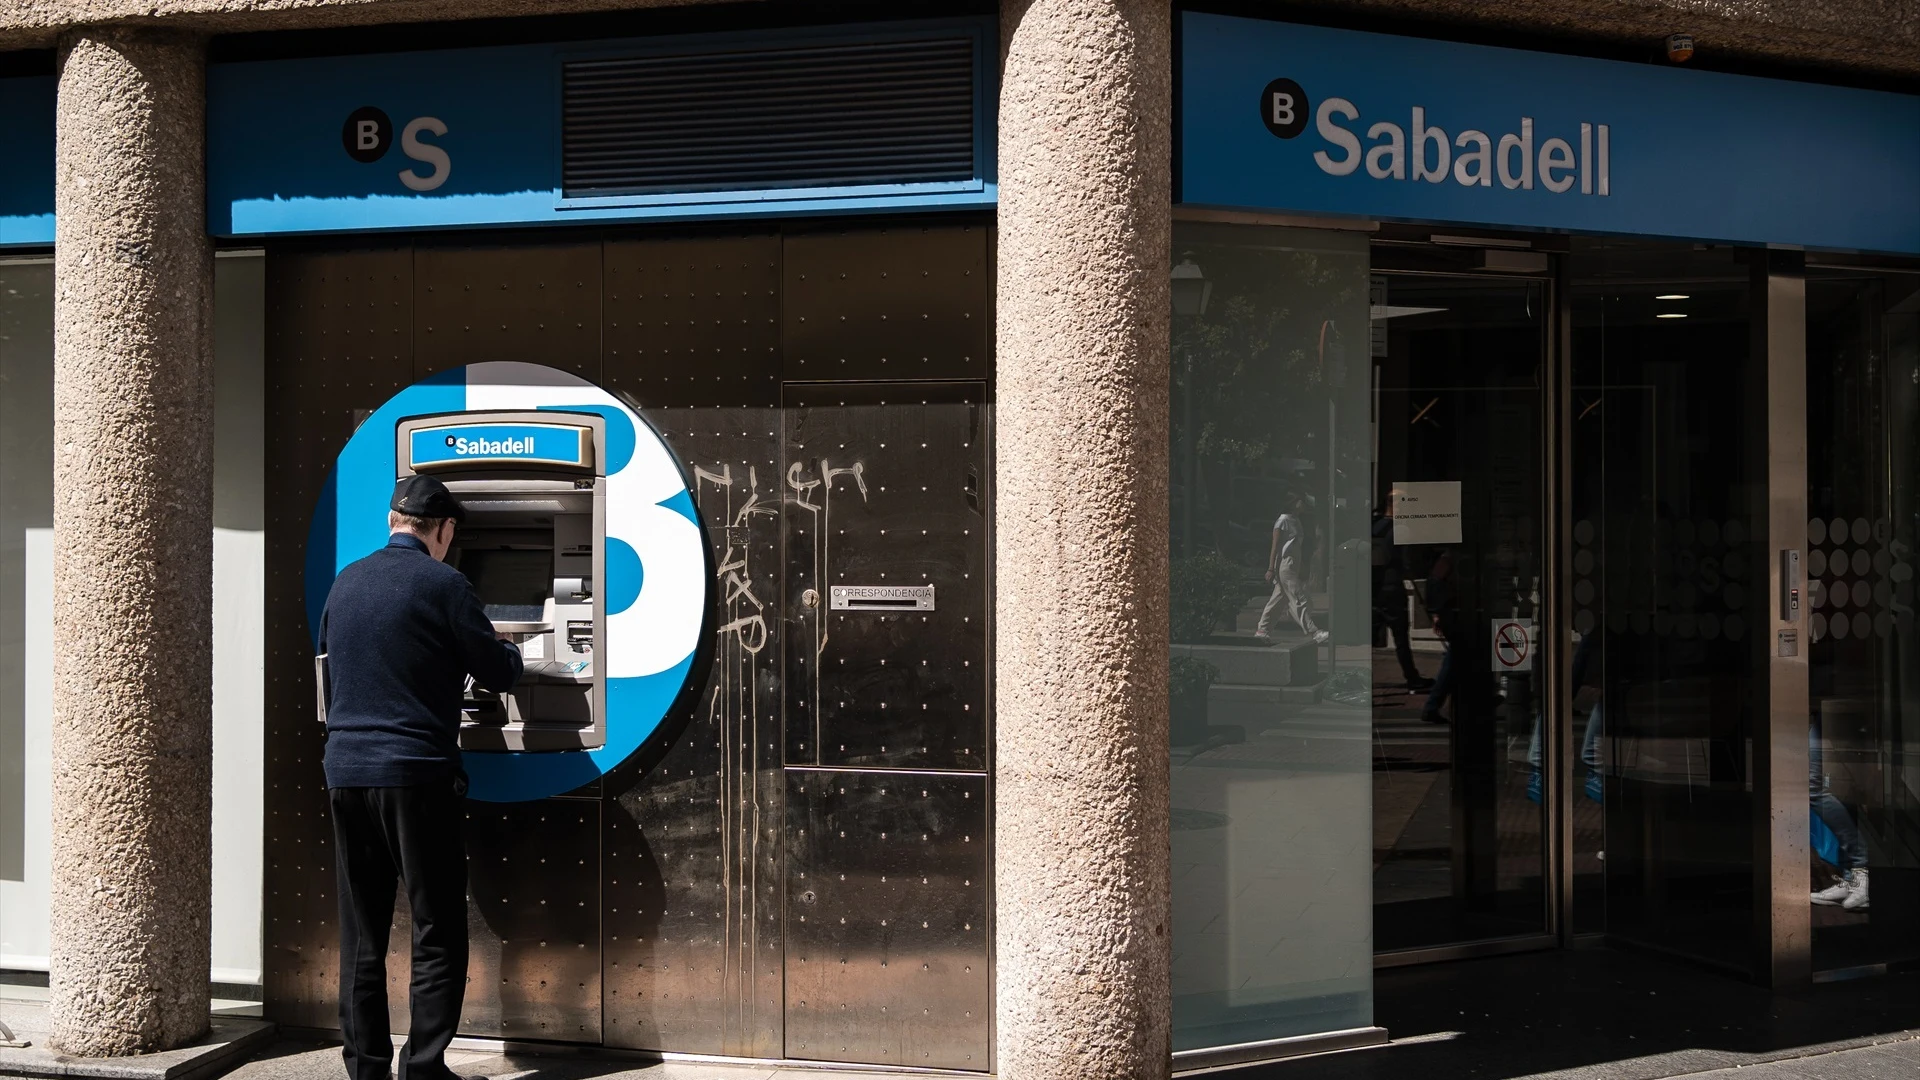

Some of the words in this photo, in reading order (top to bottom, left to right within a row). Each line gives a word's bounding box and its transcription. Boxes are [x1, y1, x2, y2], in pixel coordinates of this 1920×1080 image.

[357, 120, 379, 150] B
[398, 116, 451, 192] S
[1273, 92, 1295, 125] B
[1313, 97, 1610, 196] Sabadell
[455, 436, 534, 455] Sabadell
[833, 588, 932, 598] CORRESPONDENCIA
